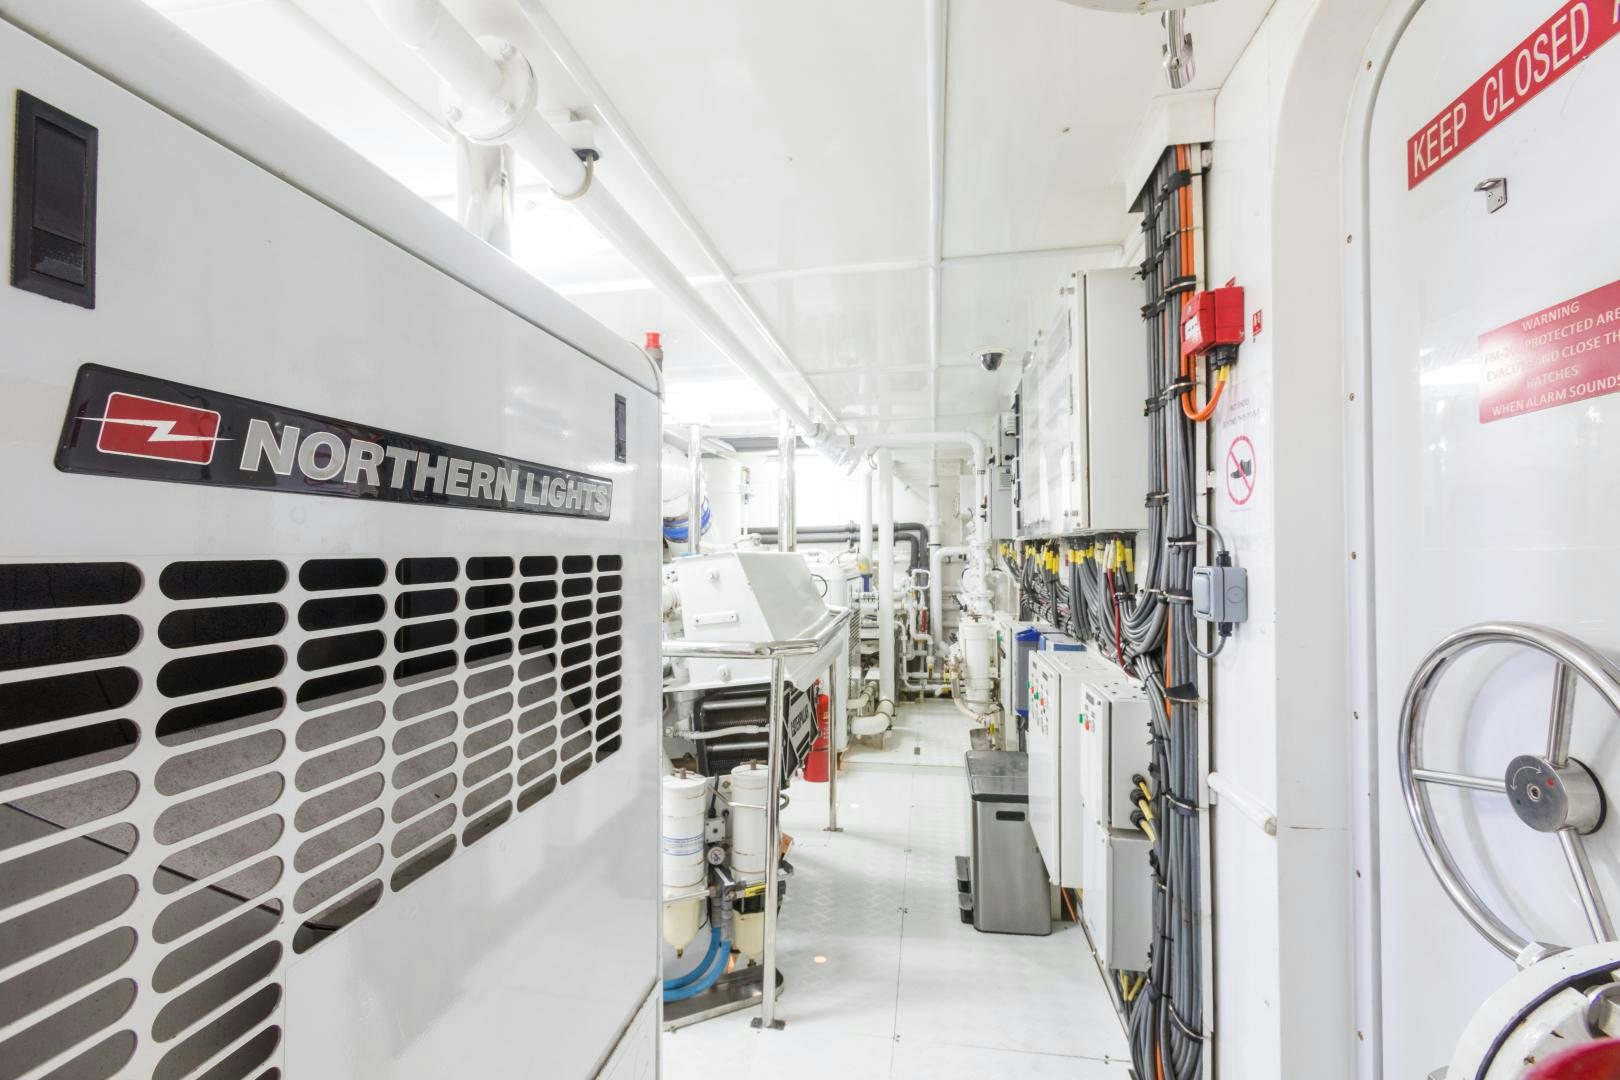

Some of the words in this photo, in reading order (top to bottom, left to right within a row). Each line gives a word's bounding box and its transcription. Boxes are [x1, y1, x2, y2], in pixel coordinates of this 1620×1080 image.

[1413, 102, 1467, 178] KEEP
[1482, 2, 1589, 122] CLOSED
[1522, 301, 1579, 331] WARNING
[1525, 318, 1593, 350] PROTECTED
[1562, 336, 1600, 358] CLOSE
[1526, 365, 1579, 388] HATCHES
[1492, 401, 1523, 416] WHEN
[1526, 388, 1567, 409] ALARM
[239, 418, 516, 503] NORTHERN
[524, 472, 609, 513] LIGHTS
